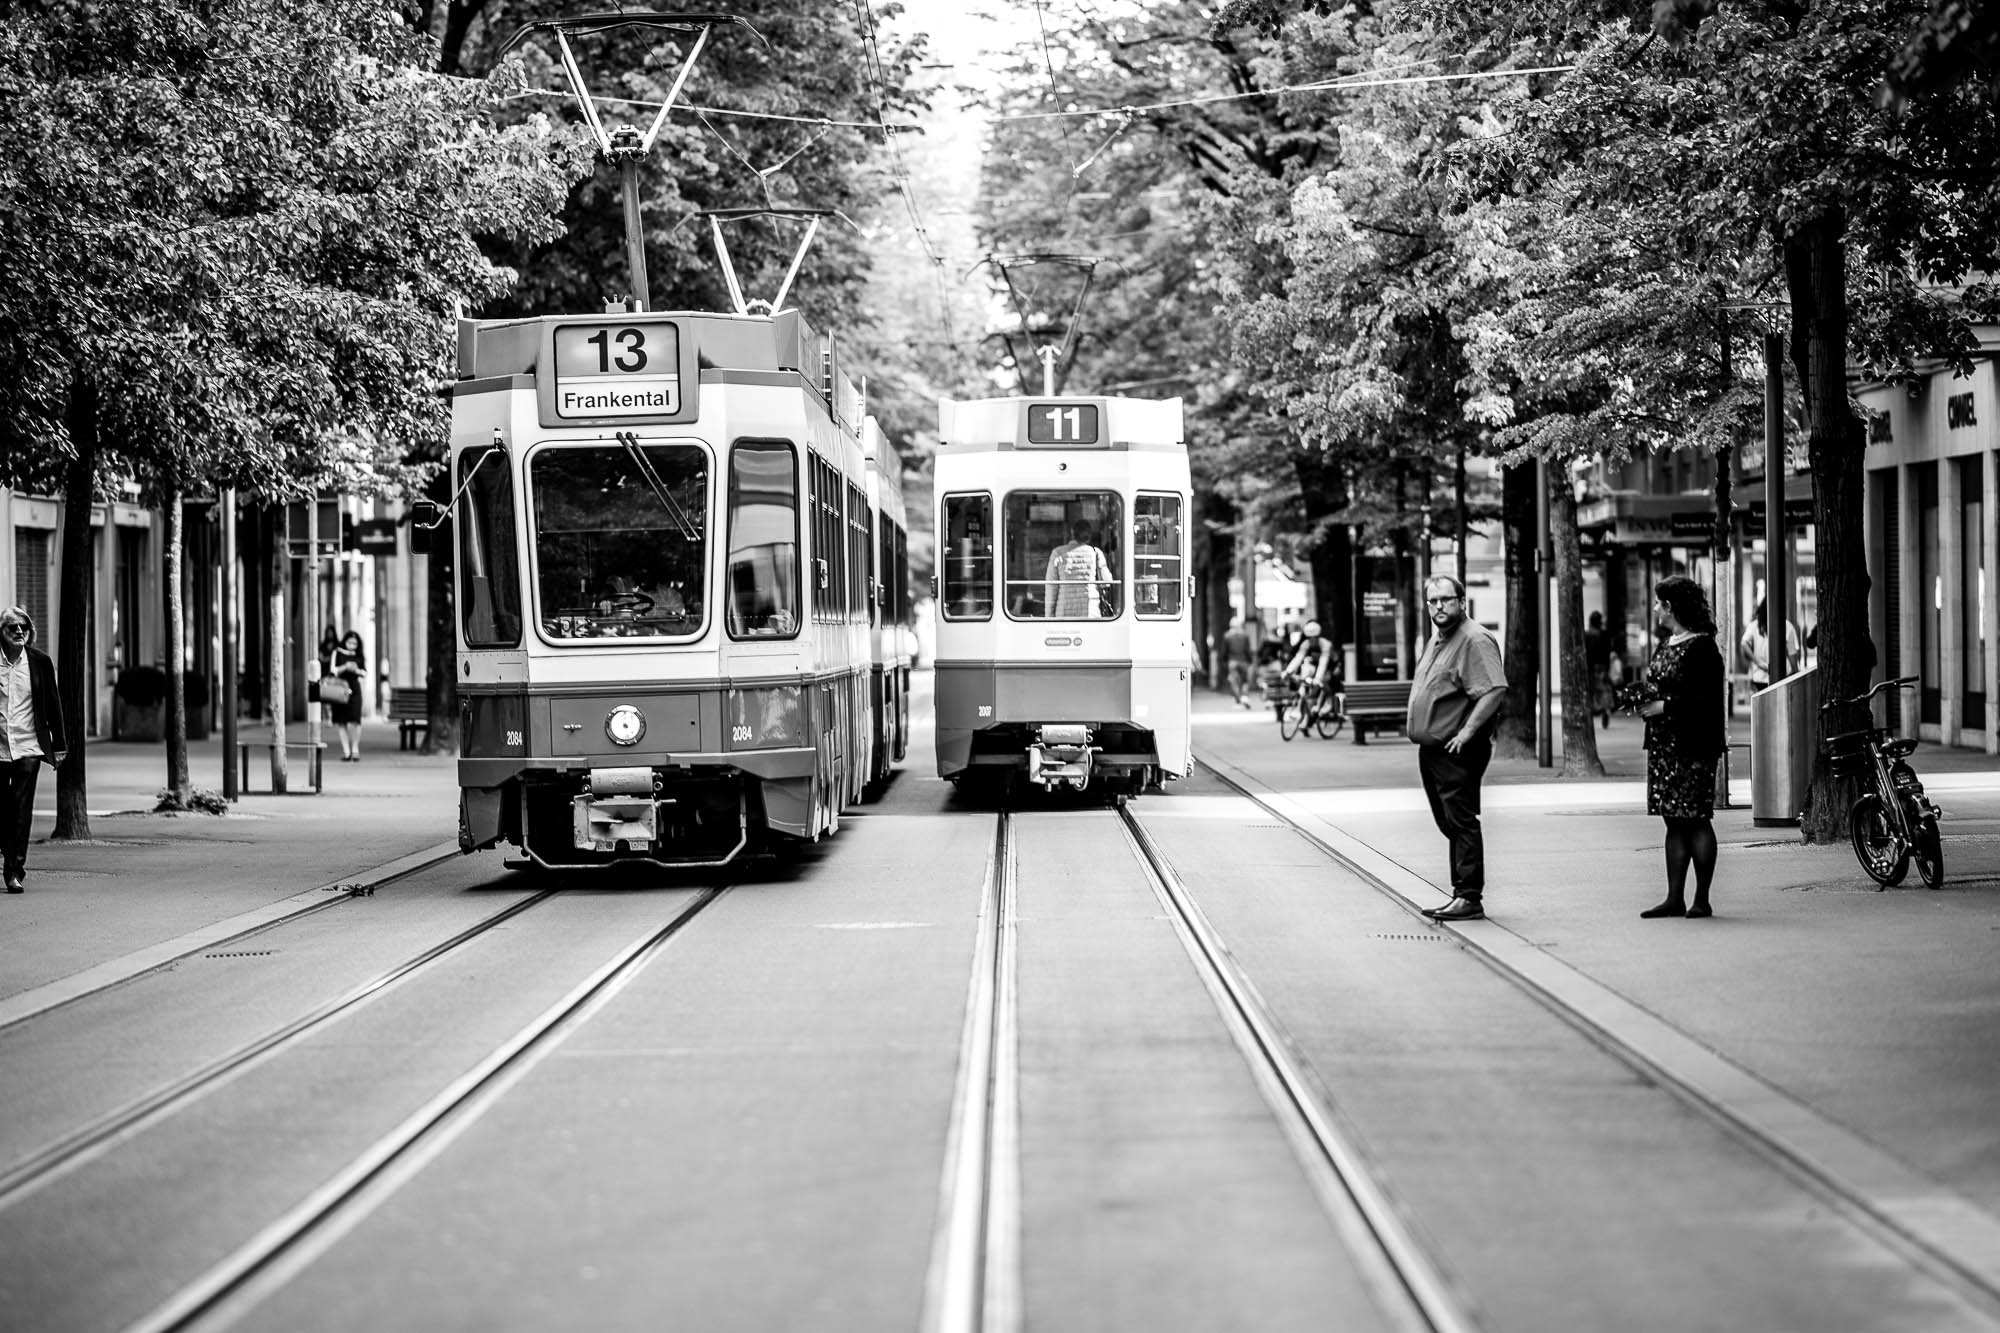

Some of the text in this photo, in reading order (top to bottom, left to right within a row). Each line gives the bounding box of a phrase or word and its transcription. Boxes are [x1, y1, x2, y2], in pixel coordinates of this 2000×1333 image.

[587, 328, 648, 373] 13
[564, 389, 670, 409] Frankental
[1045, 407, 1080, 441] 11
[506, 730, 523, 746] 2084
[732, 725, 753, 742] 2084
